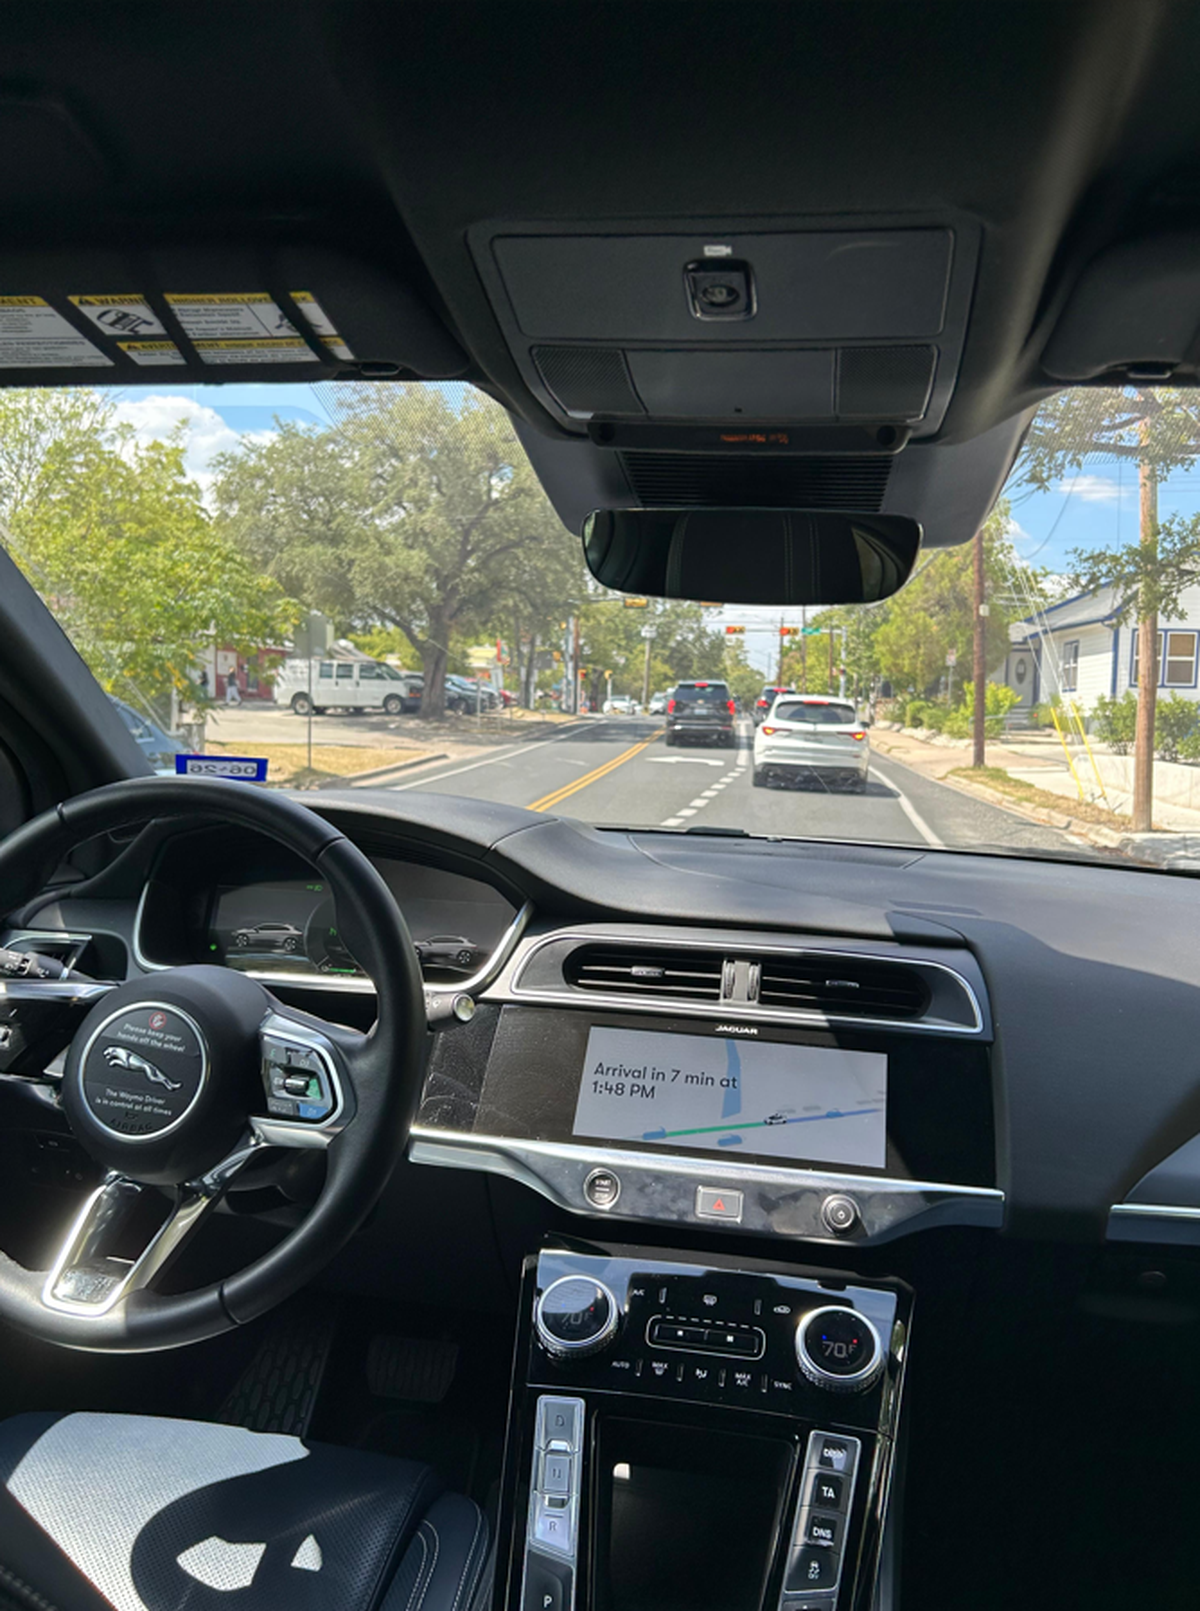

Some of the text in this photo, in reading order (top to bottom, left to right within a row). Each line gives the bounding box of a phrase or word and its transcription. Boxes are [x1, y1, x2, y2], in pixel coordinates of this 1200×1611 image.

[123, 1023, 146, 1035] Please
[715, 1025, 759, 1035] JAGUAR
[117, 1031, 138, 1043] hands
[150, 1038, 162, 1048] the
[163, 1042, 185, 1053] wheel
[594, 1062, 738, 1089] Arrival in 7 min at
[592, 1080, 655, 1099] 1:48 PM
[105, 1088, 166, 1105] The Waymo Driver
[109, 1100, 133, 1109] control
[153, 1106, 172, 1116] times
[110, 1119, 153, 1132] AIRBAG
[555, 1415, 565, 1427] D
[821, 1486, 836, 1499] TA
[548, 1520, 558, 1531] R
[543, 1595, 553, 1608] P
